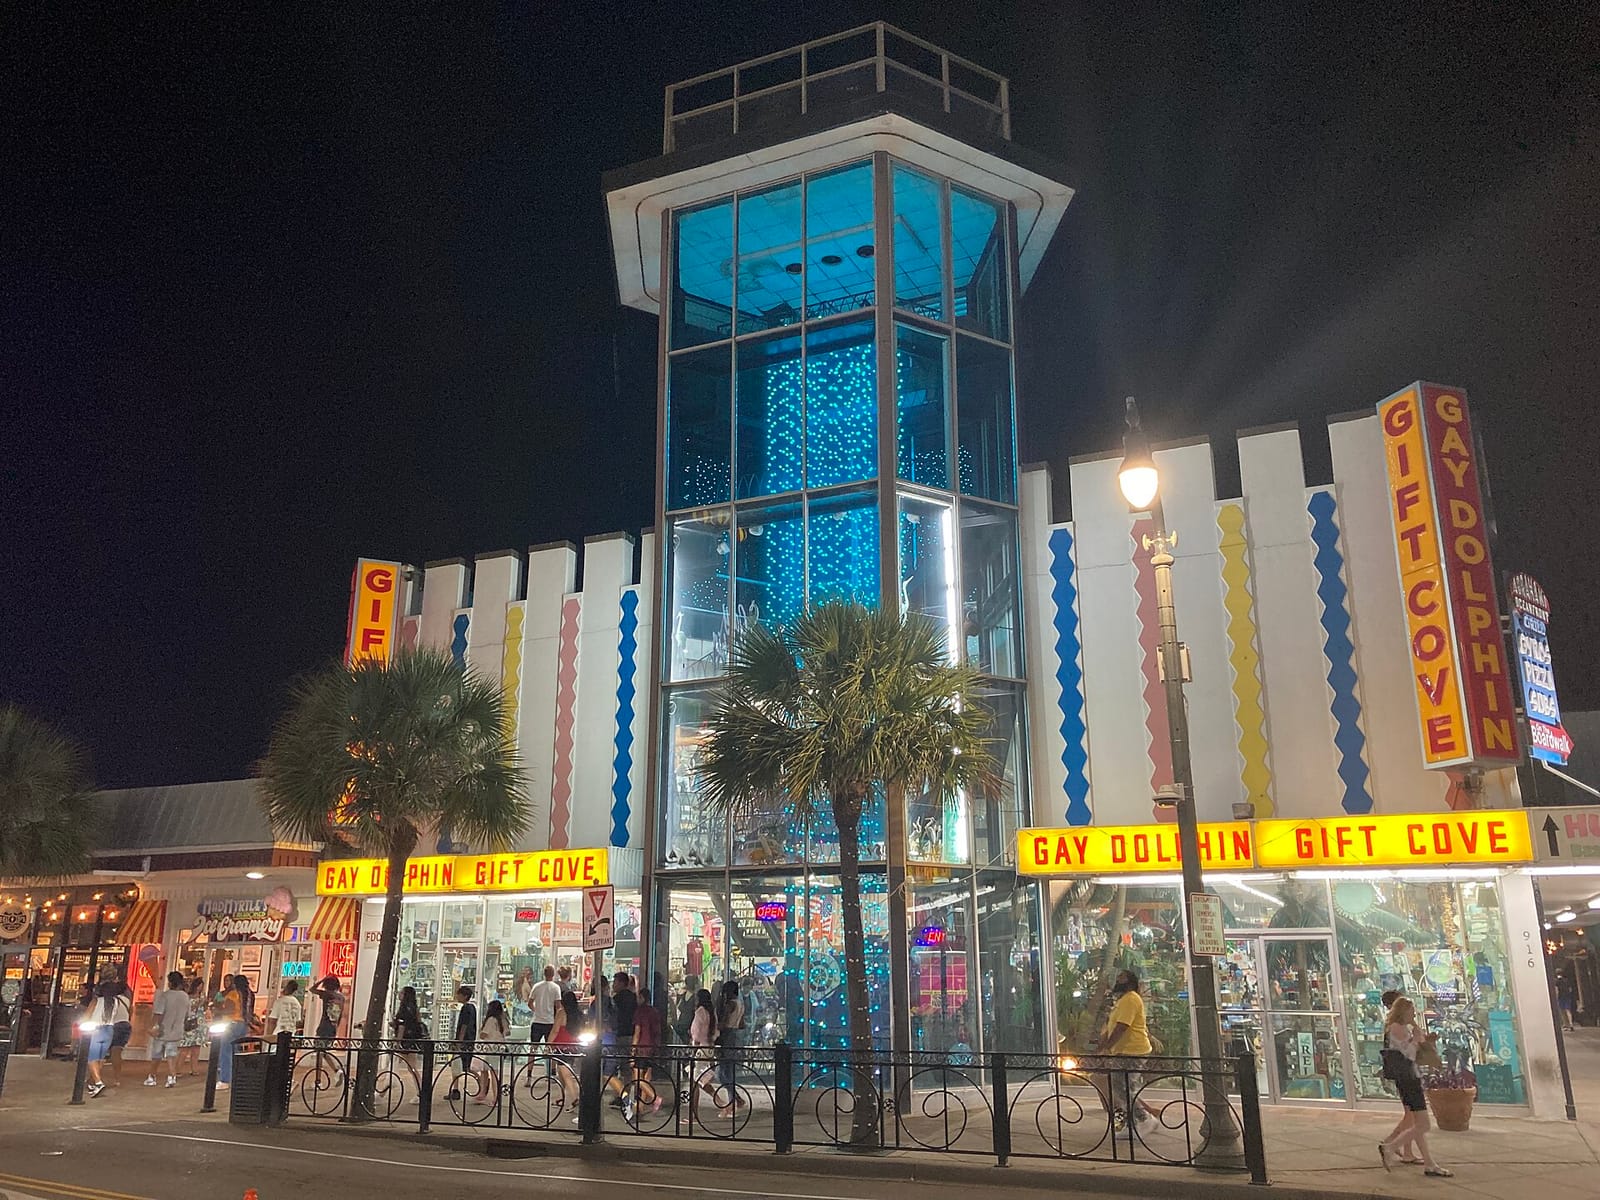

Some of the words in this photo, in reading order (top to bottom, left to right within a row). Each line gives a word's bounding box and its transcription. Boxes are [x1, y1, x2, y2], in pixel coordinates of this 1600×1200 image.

[1435, 395, 1469, 488] GAY
[1384, 401, 1426, 562] GIFT
[1406, 581, 1457, 753] COVE
[359, 569, 393, 665] GIF
[1449, 499, 1513, 751] DOLPHIN
[1519, 634, 1551, 664] GYROS
[1524, 661, 1555, 690] PIZZA
[1530, 691, 1556, 718] SUBS
[1531, 726, 1571, 754] Boardwalk
[1034, 836, 1088, 865] GAY
[1295, 825, 1376, 859] GIFT
[1407, 821, 1509, 855] COVE
[326, 866, 359, 889] GAY
[370, 863, 452, 888] DPHIN
[475, 859, 521, 885] GIFT
[538, 856, 595, 882] COVE
[756, 906, 785, 918] OPEN
[186, 916, 217, 945] Ice
[216, 916, 285, 942] Creamery
[339, 944, 352, 959] ICE
[1522, 930, 1535, 968] 916
